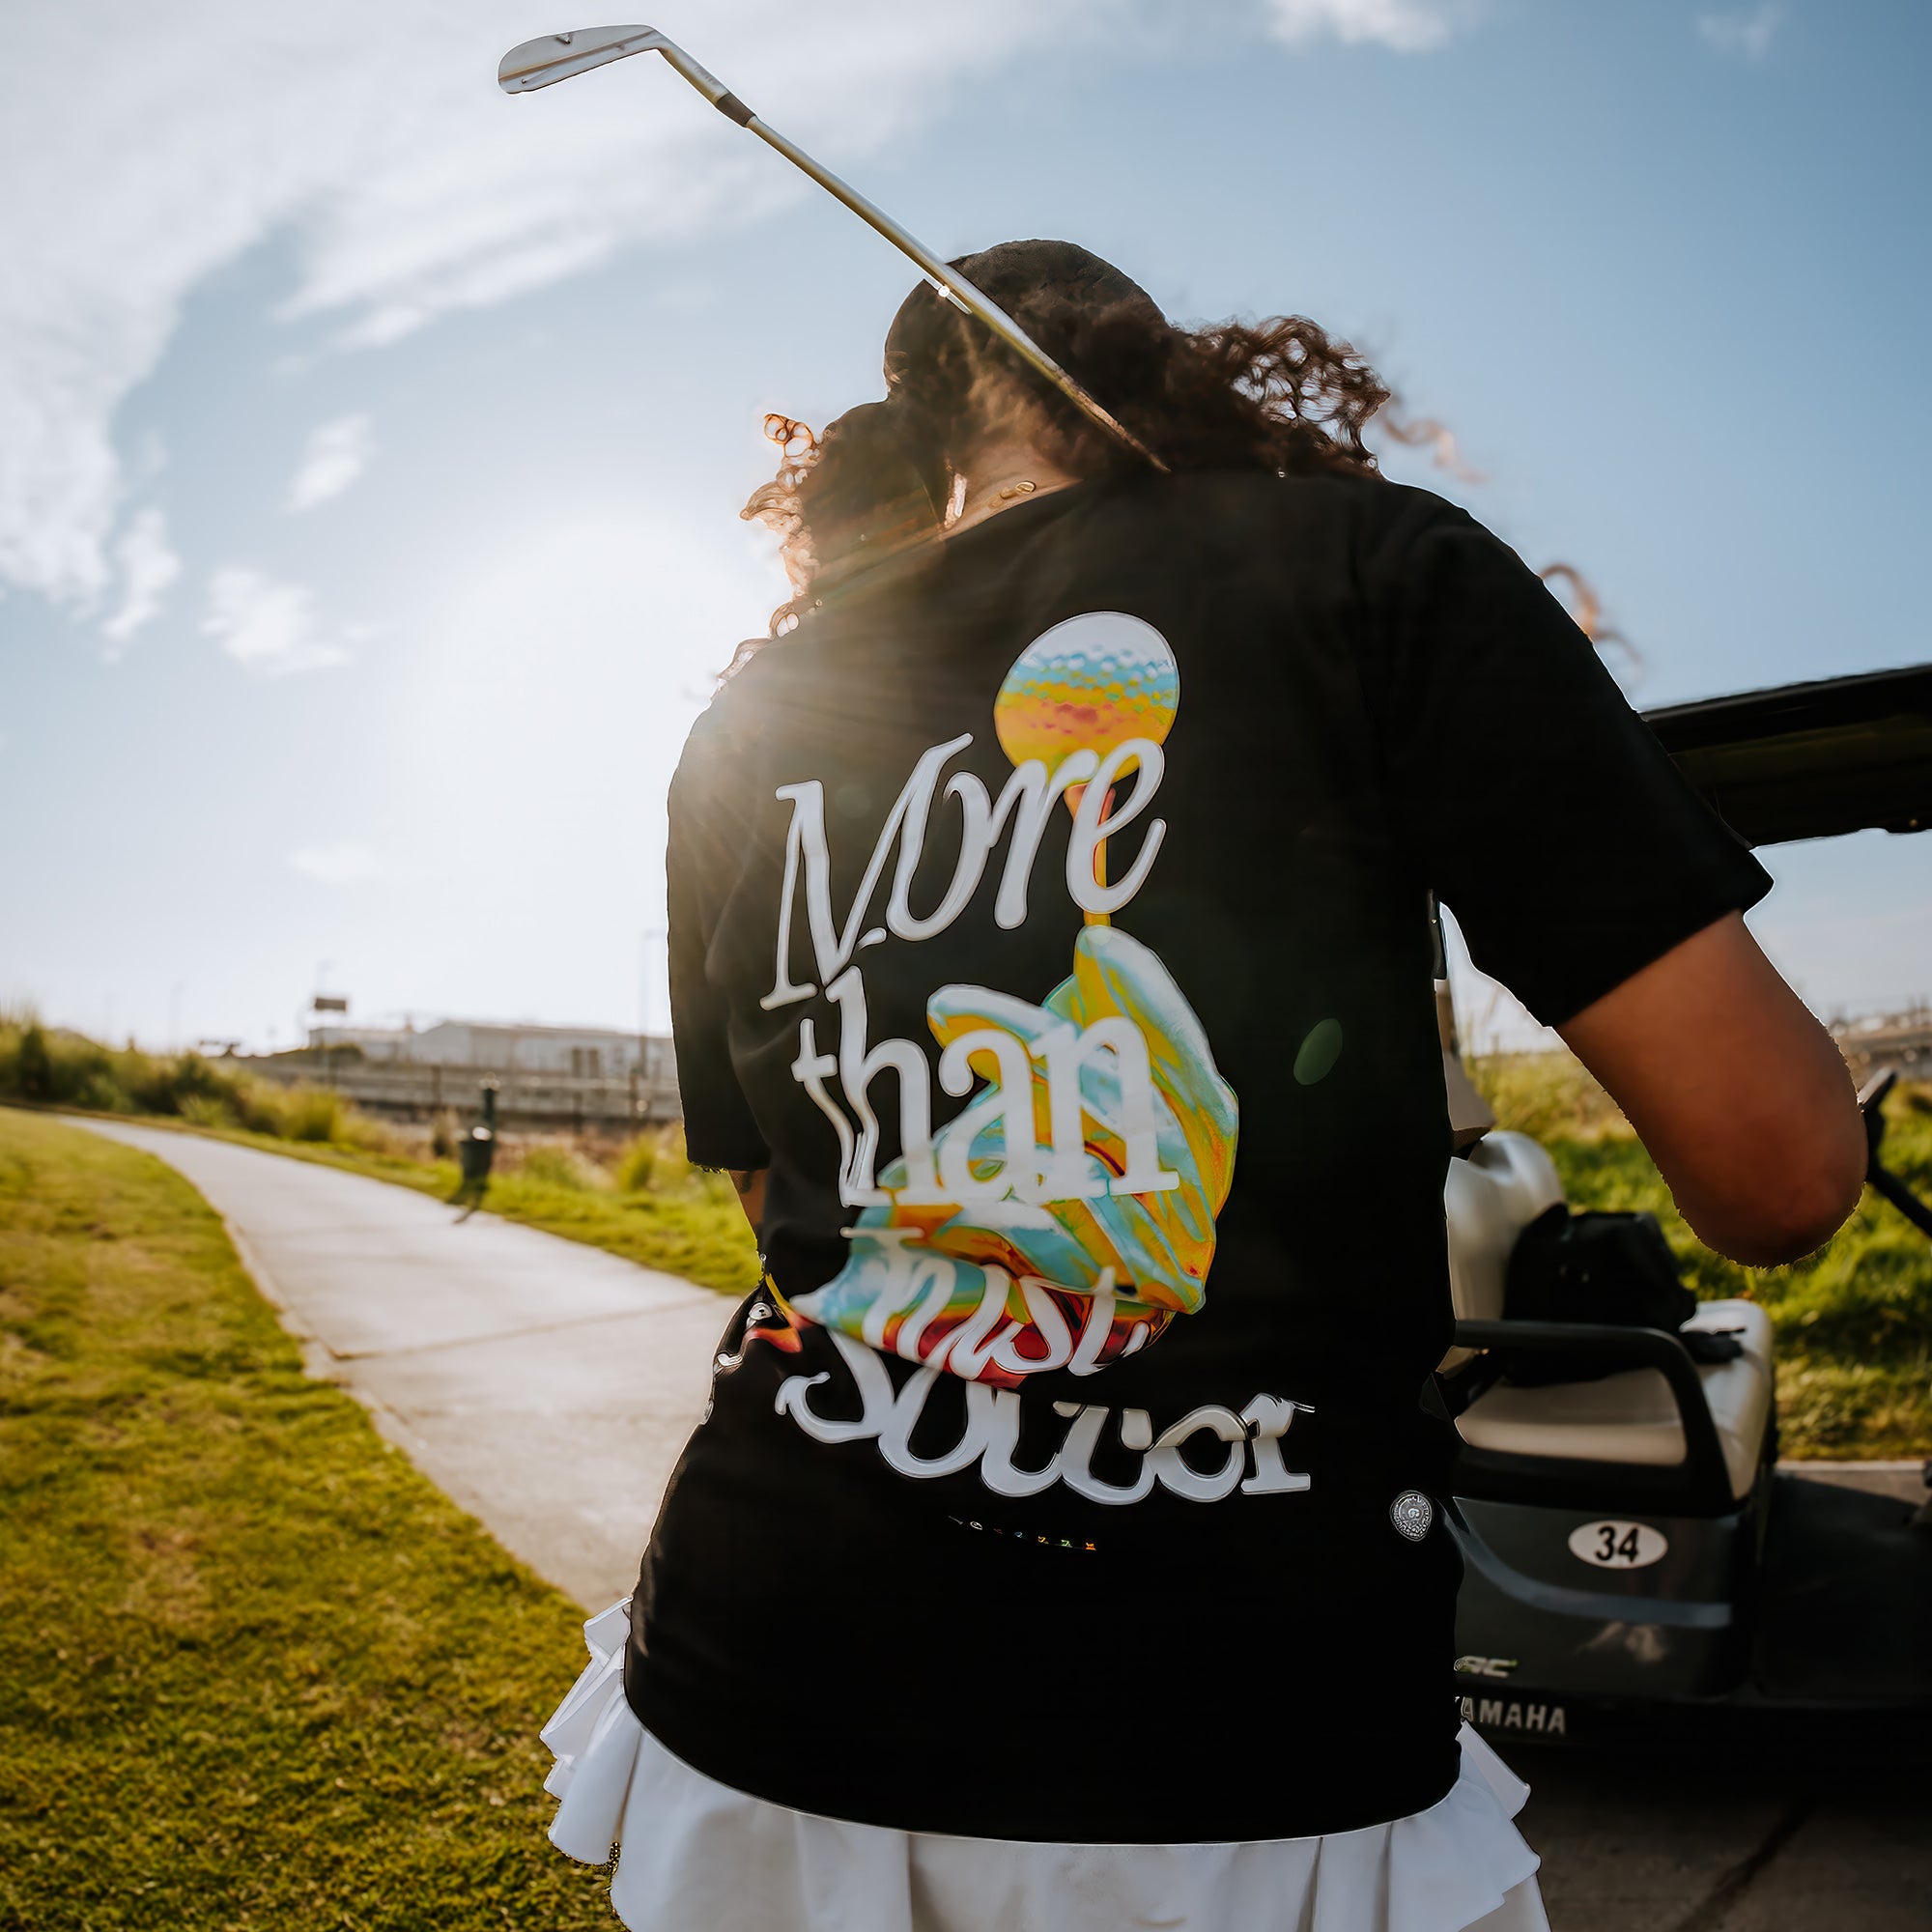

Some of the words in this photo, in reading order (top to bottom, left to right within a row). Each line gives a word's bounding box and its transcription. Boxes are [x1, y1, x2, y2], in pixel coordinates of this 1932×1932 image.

[759, 732, 1167, 1011] More
[789, 966, 1180, 1208] than
[1595, 1525, 1640, 1563] 34
[1455, 1695, 1566, 1734] AMAHA
